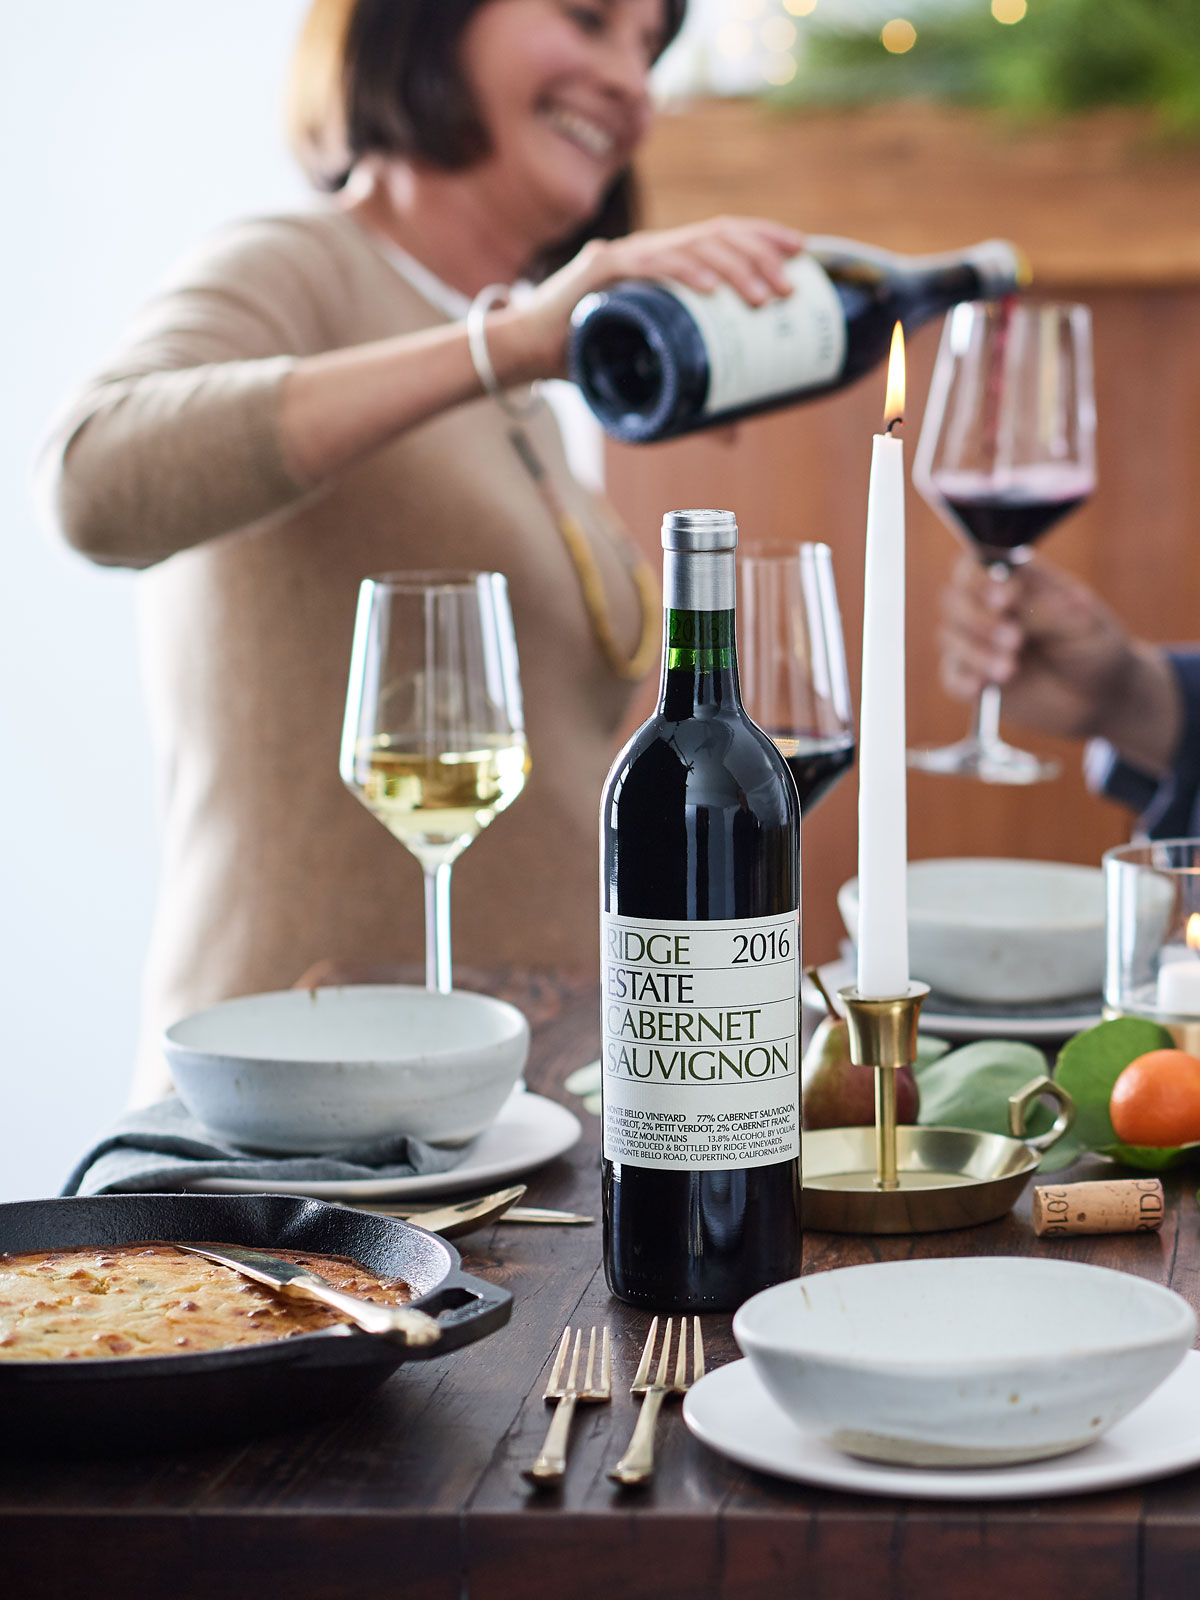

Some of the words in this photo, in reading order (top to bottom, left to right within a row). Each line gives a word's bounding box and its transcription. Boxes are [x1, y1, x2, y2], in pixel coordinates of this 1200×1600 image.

[607, 927, 690, 965] RIDGE
[731, 928, 790, 964] 2016
[607, 966, 694, 1004] ESTATE
[607, 1005, 761, 1042] CABERNET
[607, 1042, 789, 1081] SAUVIGNON
[616, 1118, 641, 1130] MERLOT,
[642, 1122, 653, 1130] 2%
[655, 1123, 676, 1132] PETIT
[677, 1124, 715, 1134] VERDOT,
[717, 1124, 730, 1132] 2%
[731, 1119, 770, 1131] CABERNET
[771, 1115, 790, 1127] FRANC
[625, 1109, 645, 1120] BELLO
[645, 1112, 686, 1122] VINEYARD
[697, 1114, 716, 1123] 77%
[717, 1111, 758, 1122] CABERNET
[621, 1129, 638, 1139] CRUZ
[639, 1132, 687, 1143] MOUNTAINS
[708, 1134, 730, 1143] 13.8%
[731, 1131, 766, 1141] ALCOHOL
[768, 1129, 776, 1137] BY
[776, 1123, 796, 1136] VOLUME
[619, 1147, 640, 1158] MONTE
[641, 1151, 662, 1160] BELLO
[663, 1153, 688, 1162] ROAD,
[690, 1152, 738, 1161] CUPERTINO,
[739, 1147, 779, 1159] CALIFORNIA
[627, 1140, 664, 1151] PRODUCED
[673, 1144, 710, 1152] BOTTLED
[711, 1144, 722, 1152] BY
[723, 1142, 747, 1151] RIDGE
[748, 1137, 783, 1149] VINEYARDS
